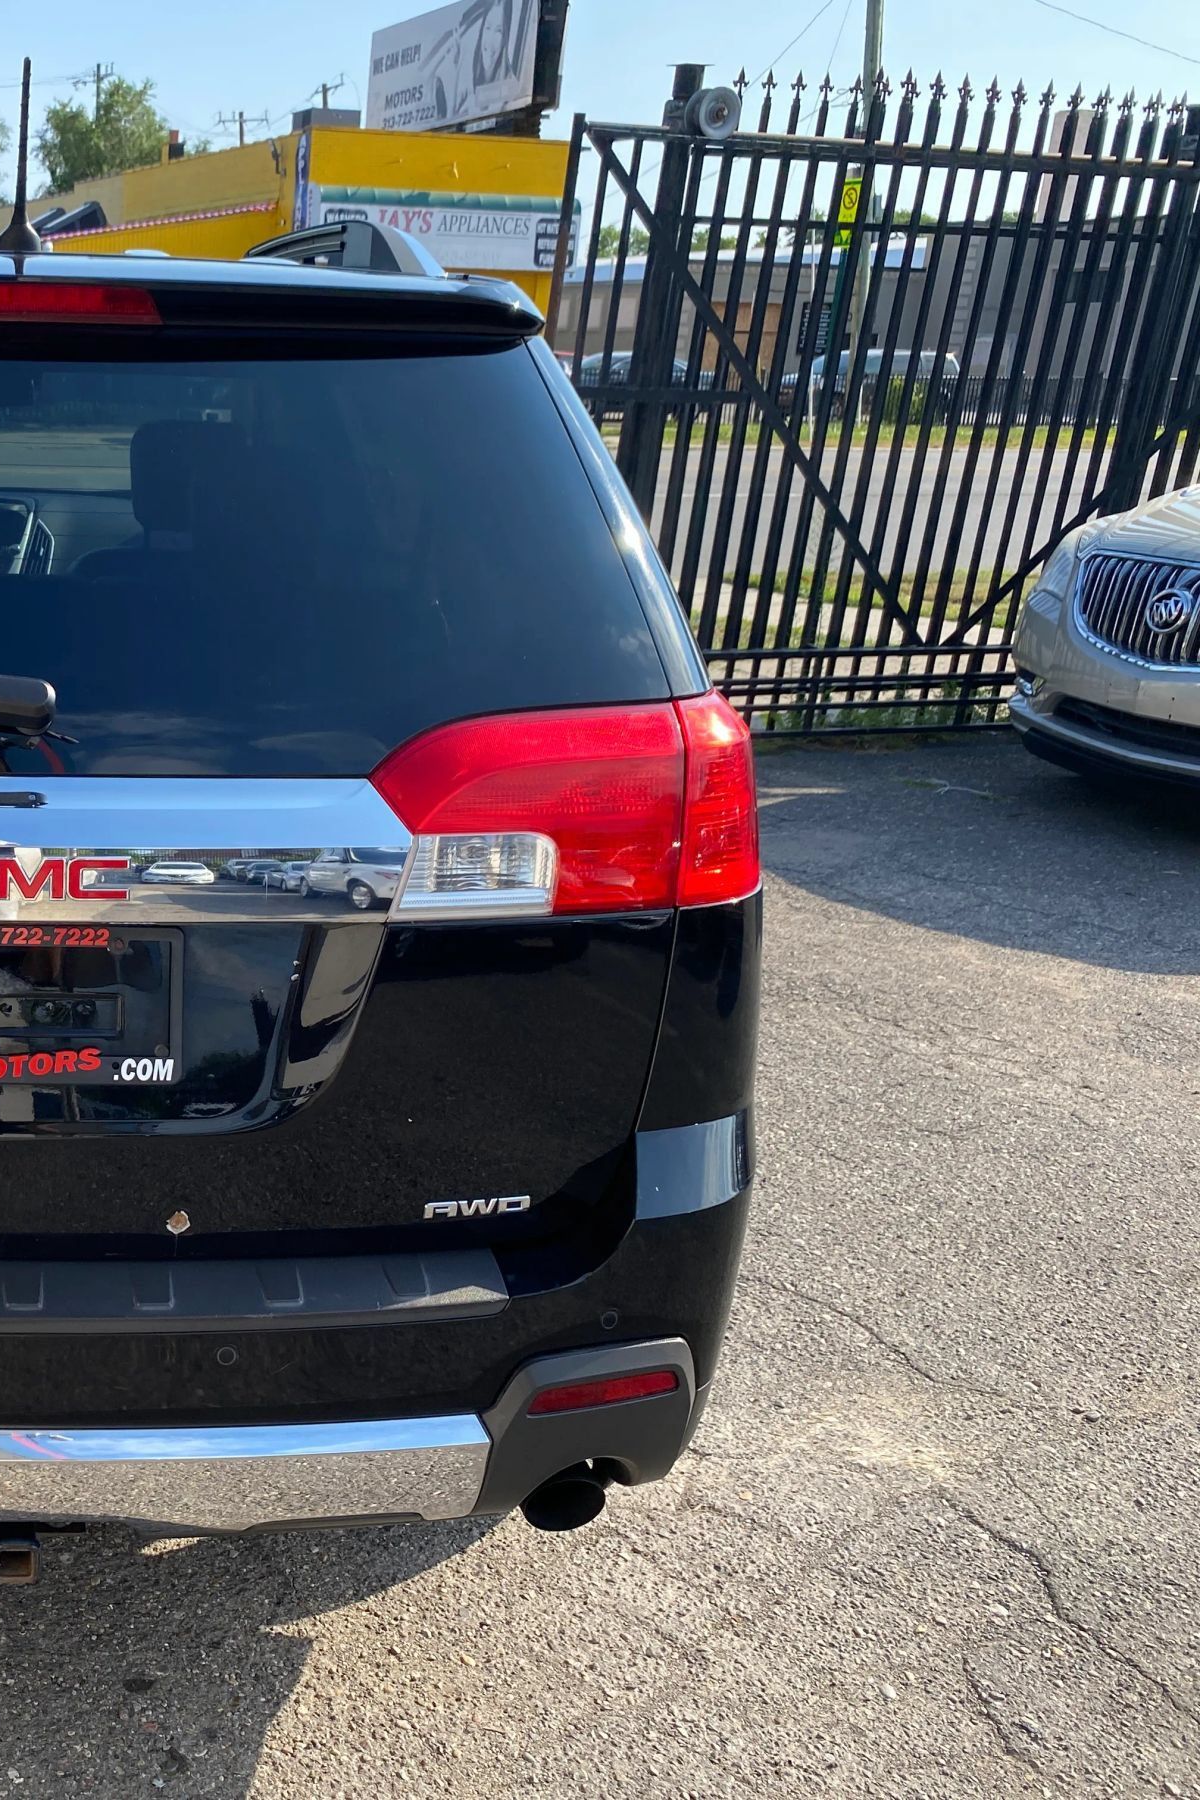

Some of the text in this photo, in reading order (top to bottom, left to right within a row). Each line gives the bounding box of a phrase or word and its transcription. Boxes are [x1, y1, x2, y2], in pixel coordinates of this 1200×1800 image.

[373, 43, 422, 76] WE CAN HELP!
[384, 84, 424, 112] MOTORS
[382, 105, 436, 130] 313-722-7222
[379, 209, 433, 233] JAY'S
[437, 213, 531, 236] APPLIANCES
[112, 1058, 175, 1081] .COM
[423, 1195, 531, 1219] AWD
